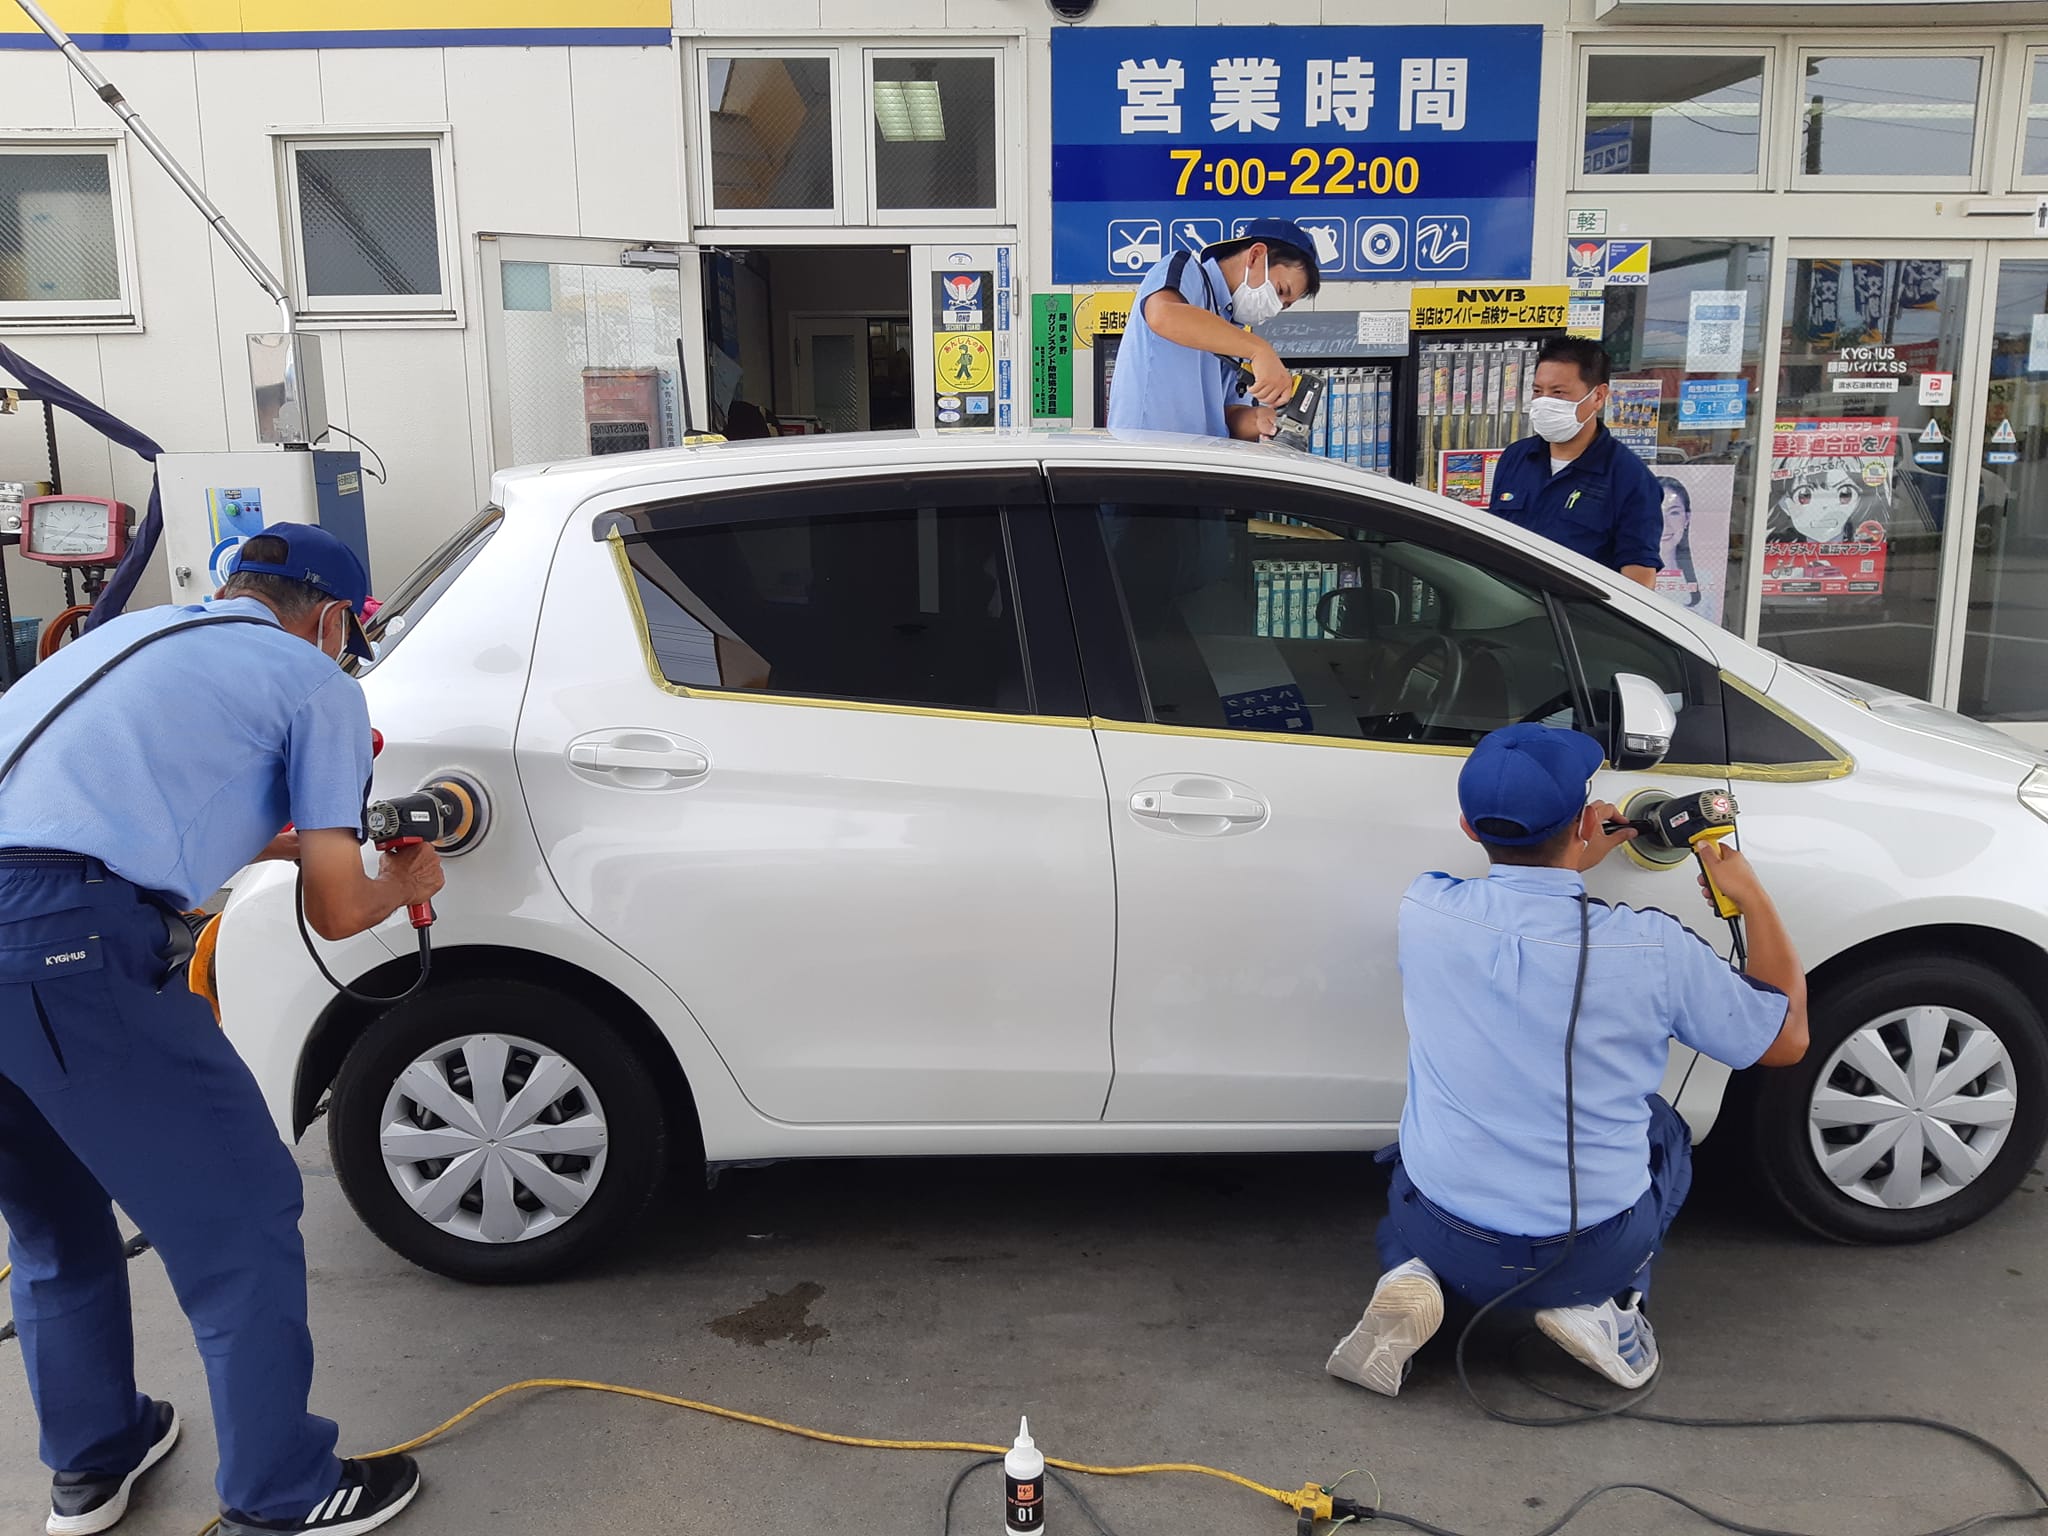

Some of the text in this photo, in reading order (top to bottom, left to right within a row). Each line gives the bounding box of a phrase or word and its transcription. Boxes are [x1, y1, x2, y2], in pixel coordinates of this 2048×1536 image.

[1117, 56, 1468, 134] 営業時間
[1170, 147, 1420, 196] 7:00-22:00
[1577, 212, 1596, 231] 軽
[1607, 274, 1647, 283] ALSOK
[1457, 288, 1526, 303] NWB
[1100, 310, 1130, 329] 当店は
[1018, 1507, 1033, 1522] 01
